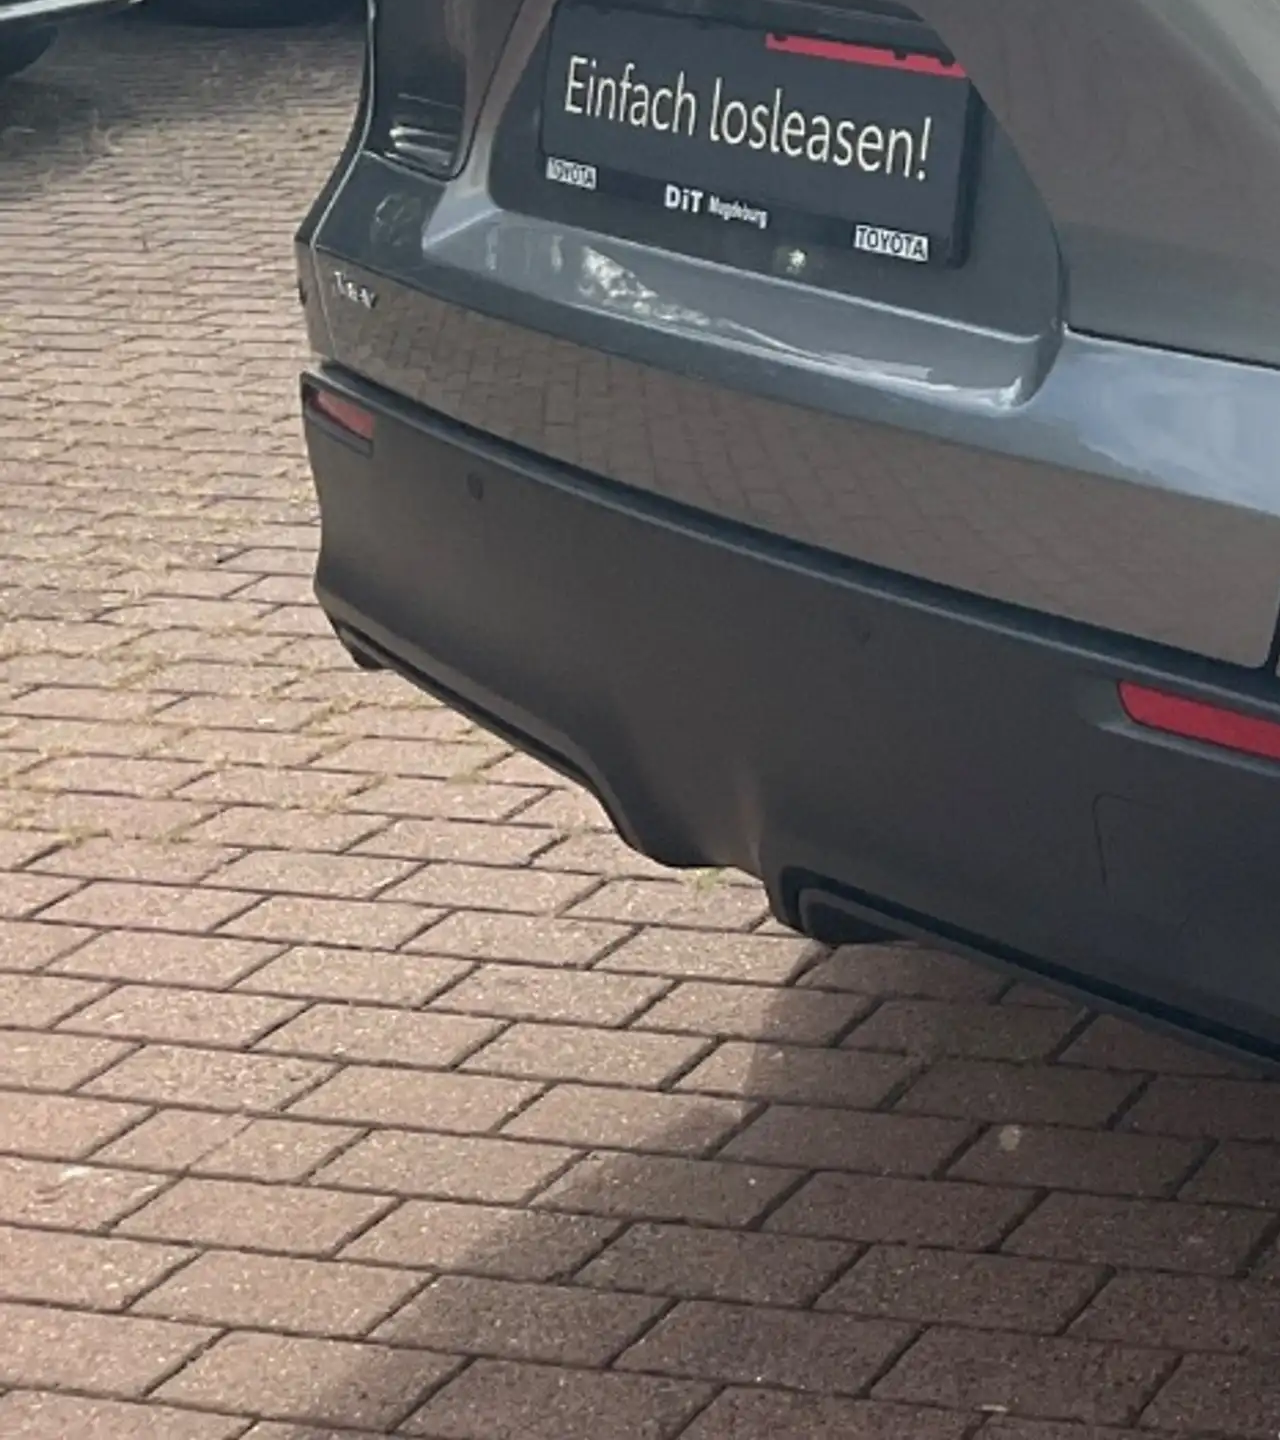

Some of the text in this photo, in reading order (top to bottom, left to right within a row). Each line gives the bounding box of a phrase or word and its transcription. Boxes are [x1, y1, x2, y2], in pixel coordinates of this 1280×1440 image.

[564, 55, 933, 181] Einfach losleasen!
[664, 183, 703, 214] DiT
[855, 226, 928, 261] TOYOTA
